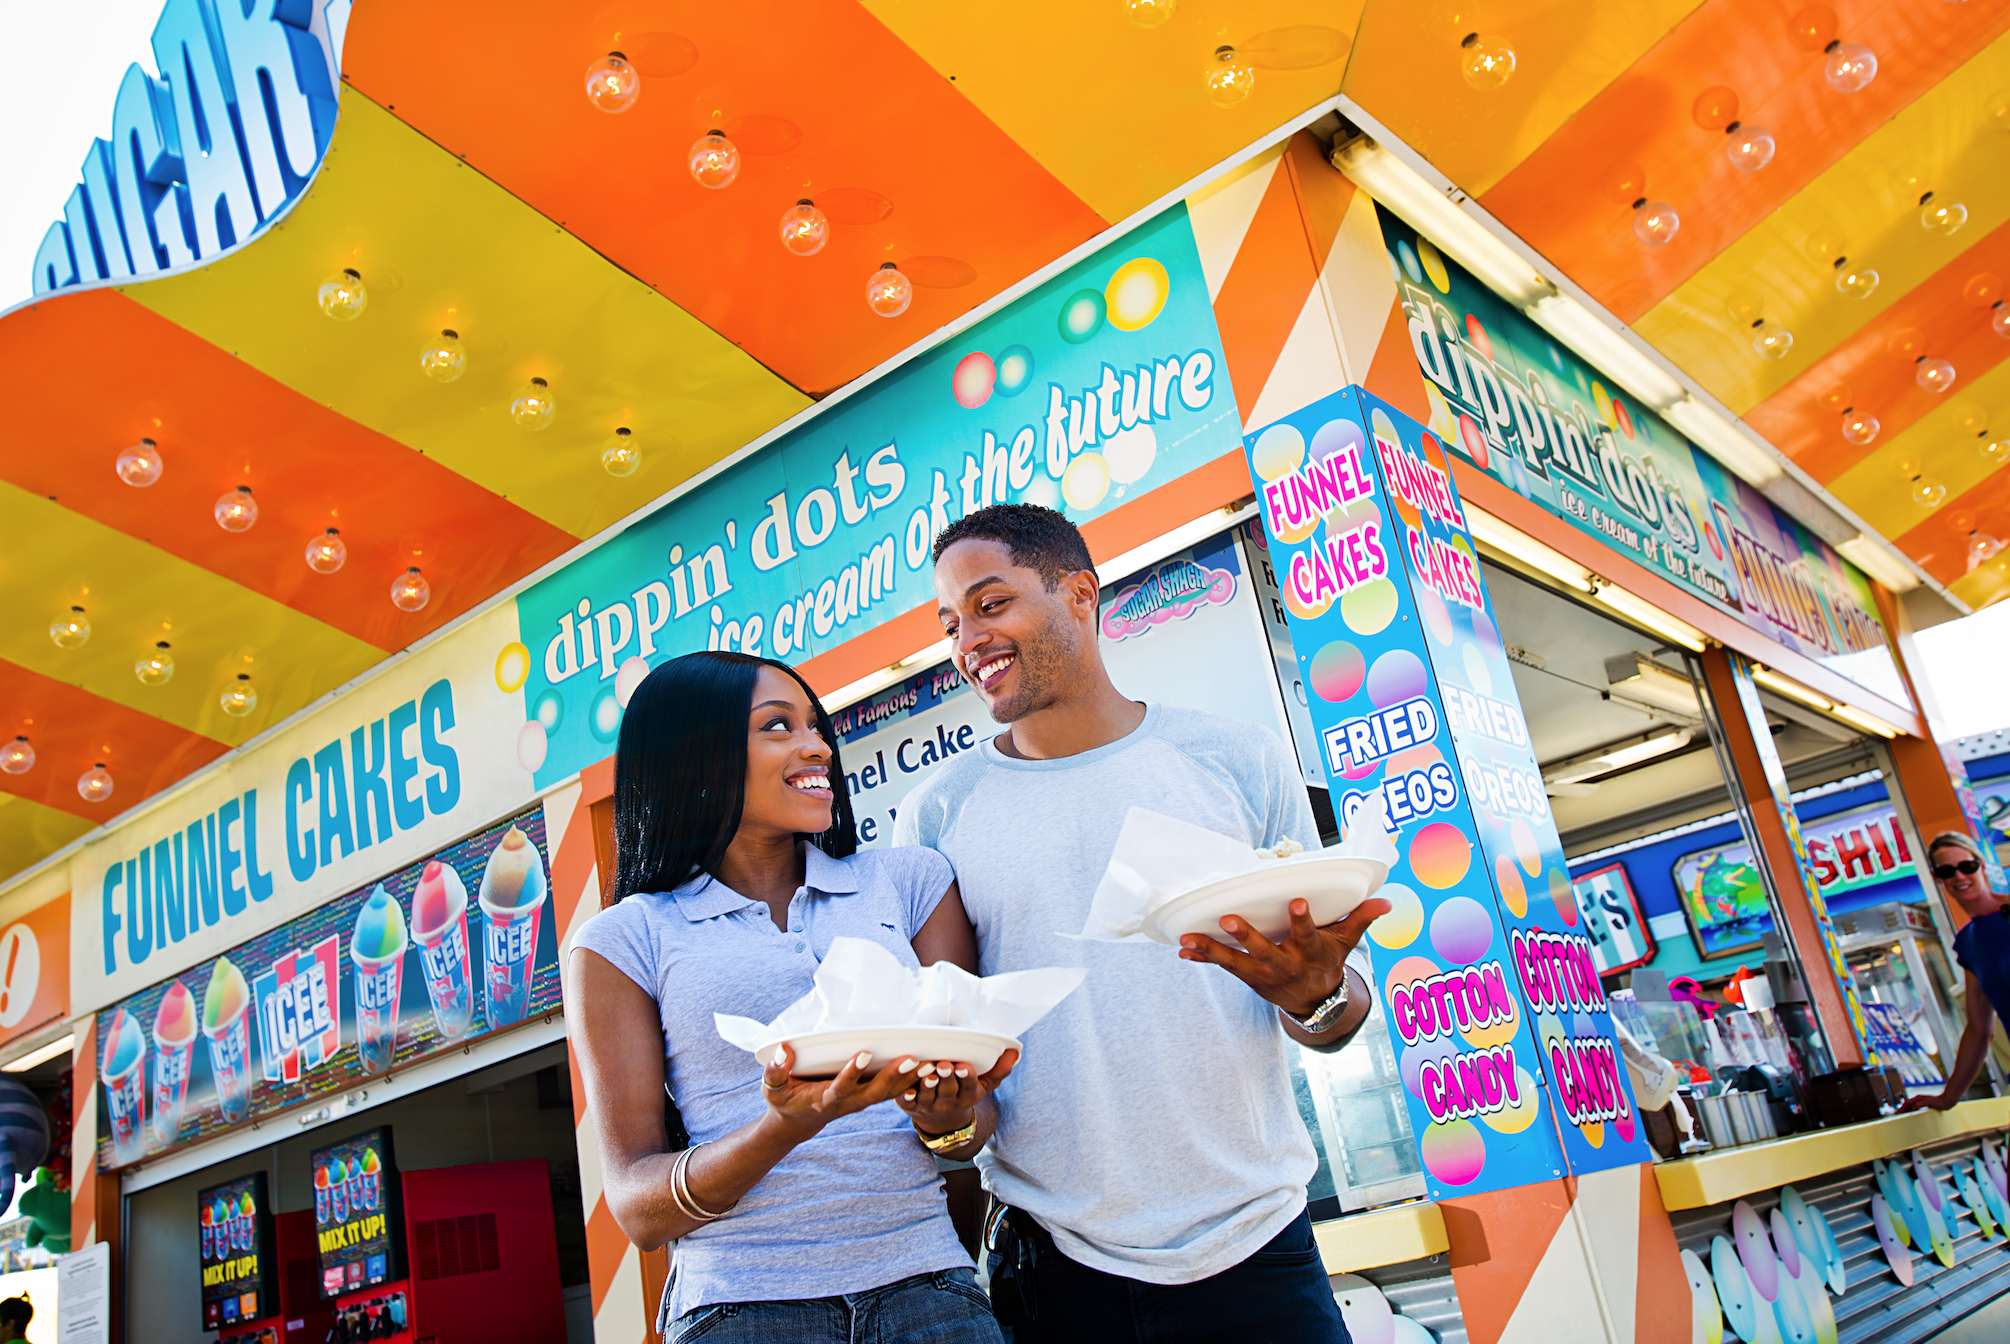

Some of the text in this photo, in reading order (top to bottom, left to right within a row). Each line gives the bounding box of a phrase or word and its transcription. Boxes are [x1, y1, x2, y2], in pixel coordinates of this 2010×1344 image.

[707, 604, 764, 657] ice
[771, 534, 896, 655] cream
[905, 468, 954, 572] of
[958, 425, 1036, 516] the
[1046, 349, 1214, 481] future
[1264, 443, 1373, 538] FUNNEL
[1374, 434, 1466, 531] FUNNEL
[1595, 420, 1700, 556] dots
[543, 436, 907, 684] dippin' dots
[1291, 524, 1387, 608] CAKES
[1408, 527, 1485, 613] CAKES
[1559, 478, 1588, 521] ice
[1591, 506, 1641, 552] cream
[1643, 534, 1659, 563] of
[1661, 541, 1688, 579] the
[1120, 560, 1206, 622] SUGAR SHACK
[1710, 498, 1838, 656] Funnel
[896, 724, 975, 774] Cake
[1323, 697, 1437, 776] FRIED
[1443, 682, 1528, 750] FRIED
[102, 679, 462, 976] FUNNEL CAKES
[1464, 753, 1547, 819] OREOS
[423, 922, 465, 982] ICEE
[487, 915, 532, 966] ICEE
[1511, 929, 1606, 1014] COTTON
[264, 961, 331, 1062] ICEE
[358, 962, 397, 1011] ICEE
[1392, 961, 1514, 1046] COTTON
[158, 1049, 187, 1086] ICEE
[212, 1019, 246, 1069] ICEE
[1420, 1043, 1522, 1125] CANDY
[1549, 1036, 1629, 1126] CANDY
[110, 1069, 141, 1118] ICEE
[203, 1254, 258, 1287] MIX IT UP!
[318, 1213, 386, 1253] MIX IT UP!
